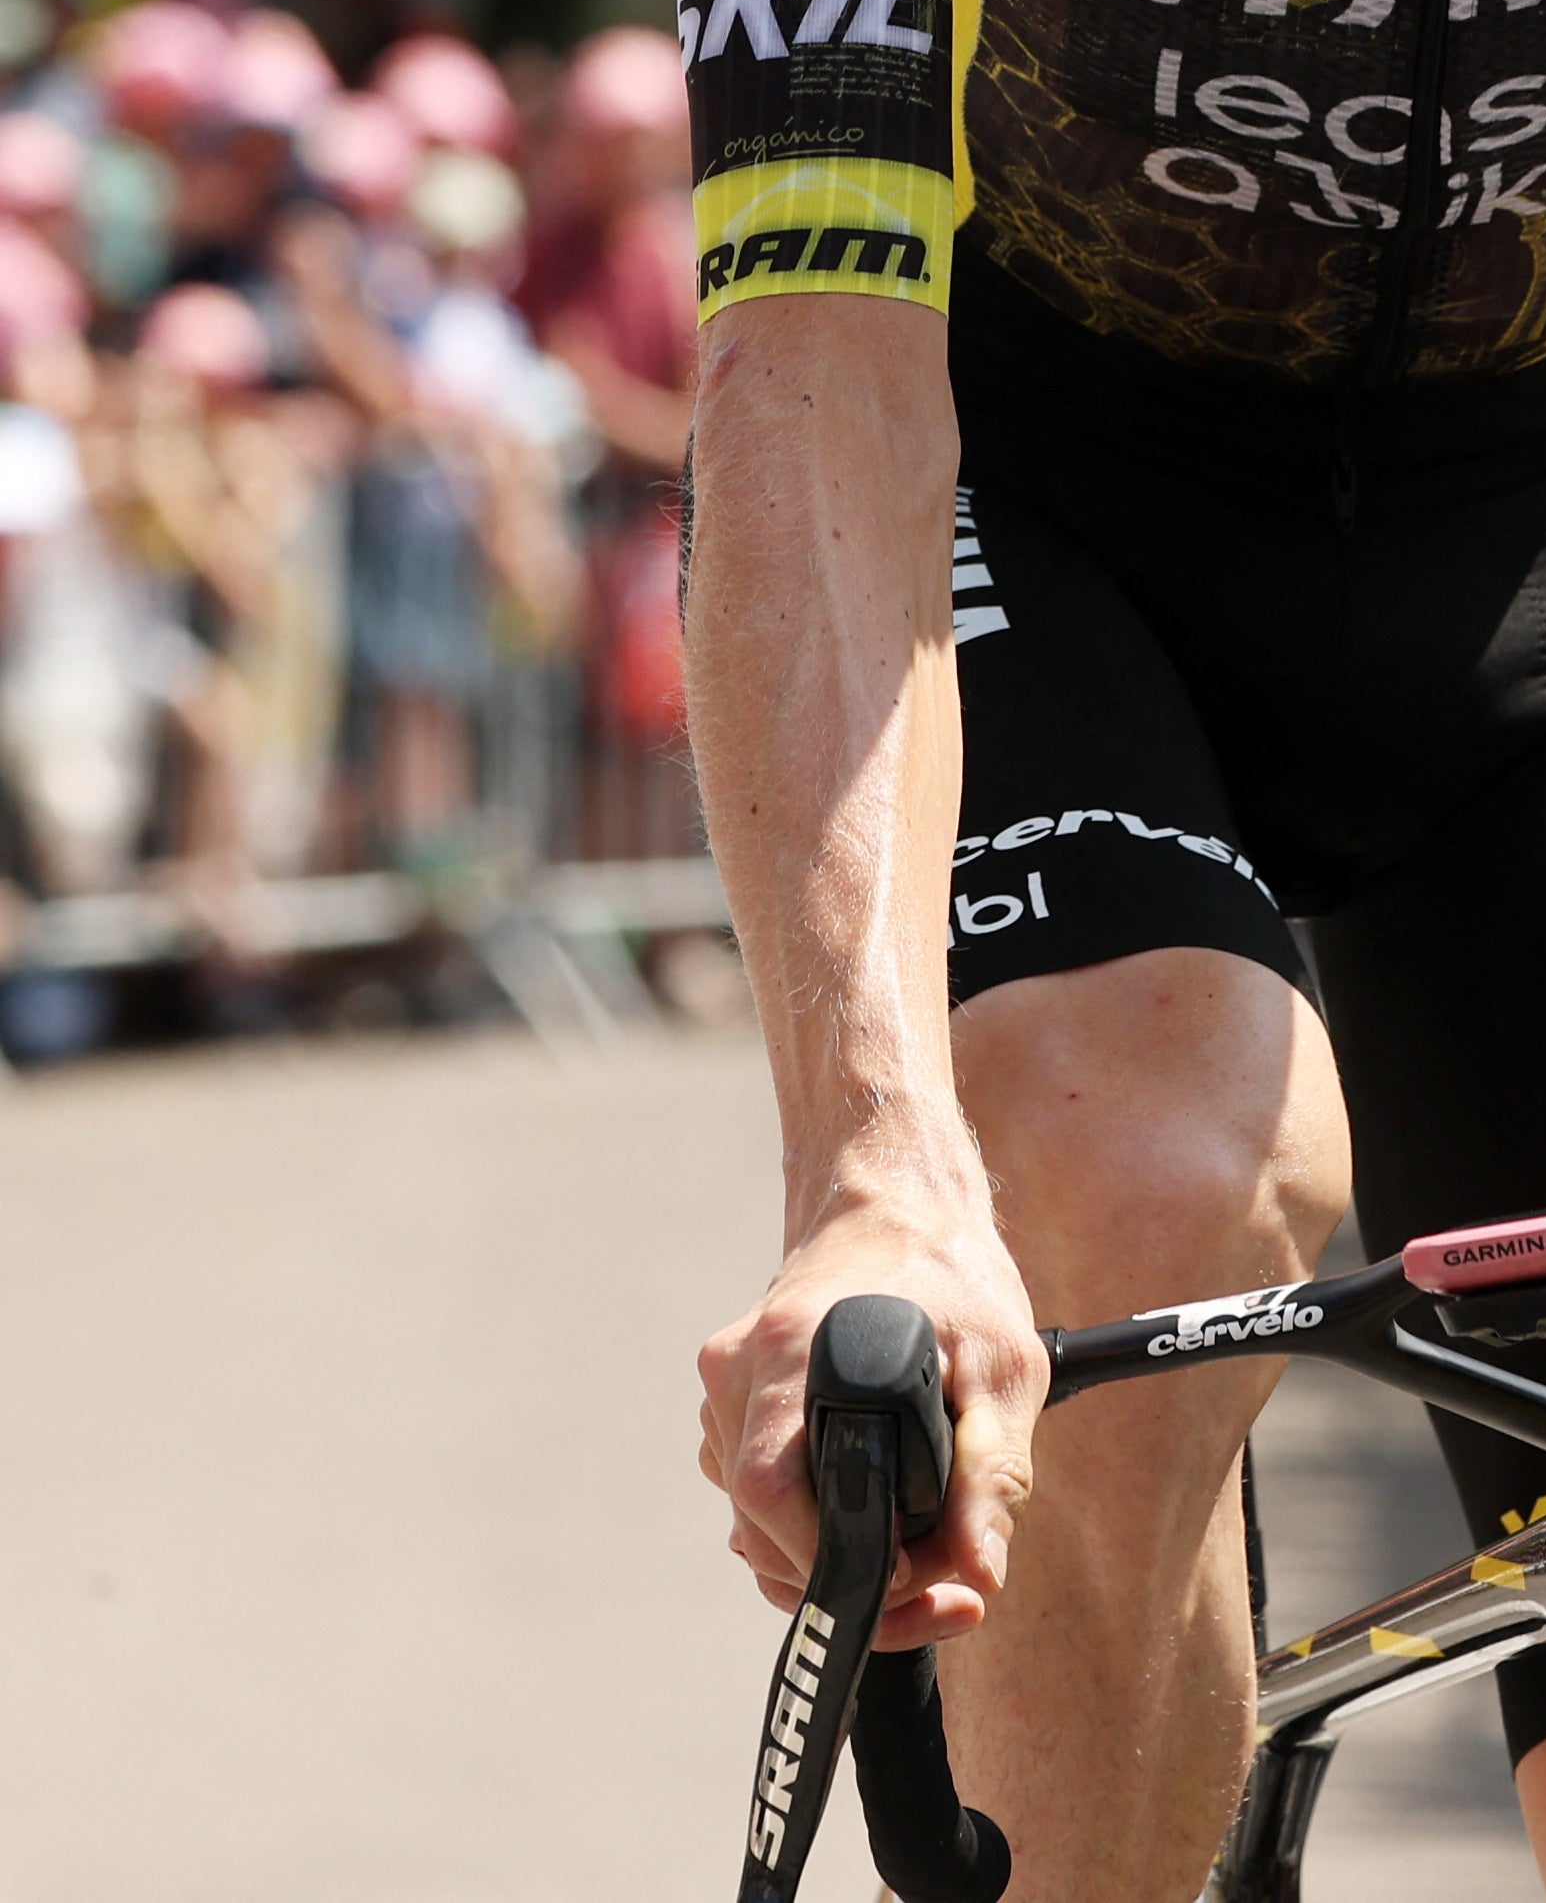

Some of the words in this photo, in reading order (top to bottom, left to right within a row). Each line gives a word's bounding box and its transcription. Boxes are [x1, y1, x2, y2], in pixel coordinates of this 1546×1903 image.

[724, 116, 864, 168] orgánico
[697, 227, 927, 303] RAM
[1443, 1236, 1545, 1266] GARMIN
[749, 1602, 836, 1871] SRAM
